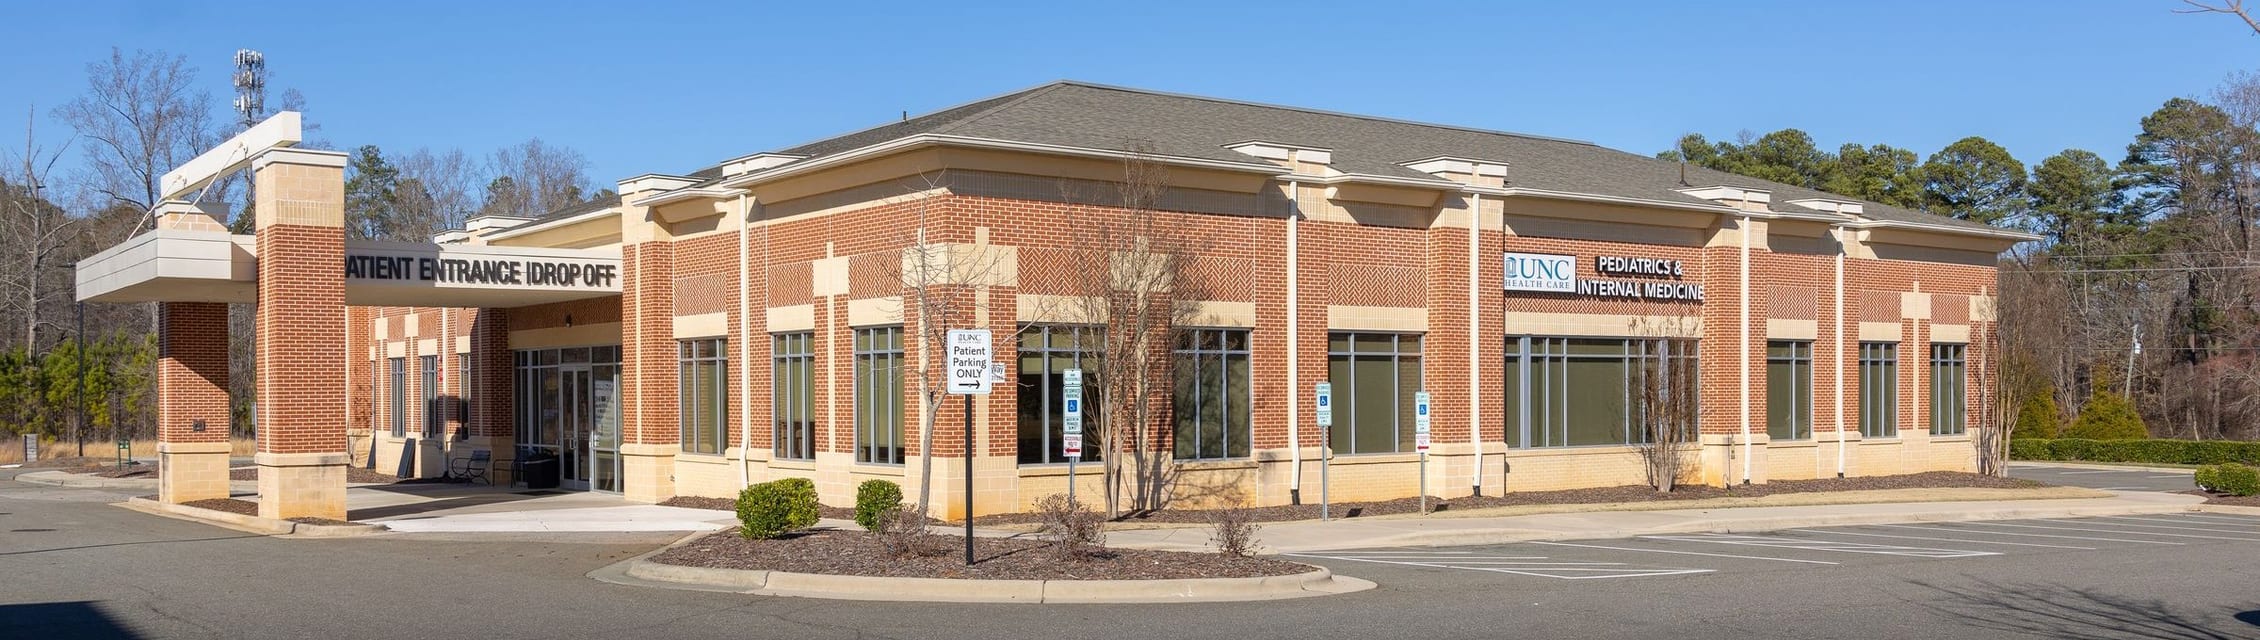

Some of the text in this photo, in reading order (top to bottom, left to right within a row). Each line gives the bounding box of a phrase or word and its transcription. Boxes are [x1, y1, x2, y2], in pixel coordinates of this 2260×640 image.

[344, 255, 414, 280] ATIENT
[419, 257, 522, 285] ENTRANCE
[583, 263, 617, 288] OFF
[1519, 257, 1570, 281] UNC
[1599, 255, 1684, 276] PEDIATRICS &
[1504, 279, 1570, 289] HEALTH CARE
[1577, 279, 1704, 300] INTERNAL MEDICINE
[953, 345, 986, 356] Patient
[953, 357, 987, 370] Parking
[956, 368, 983, 379] ONLY
